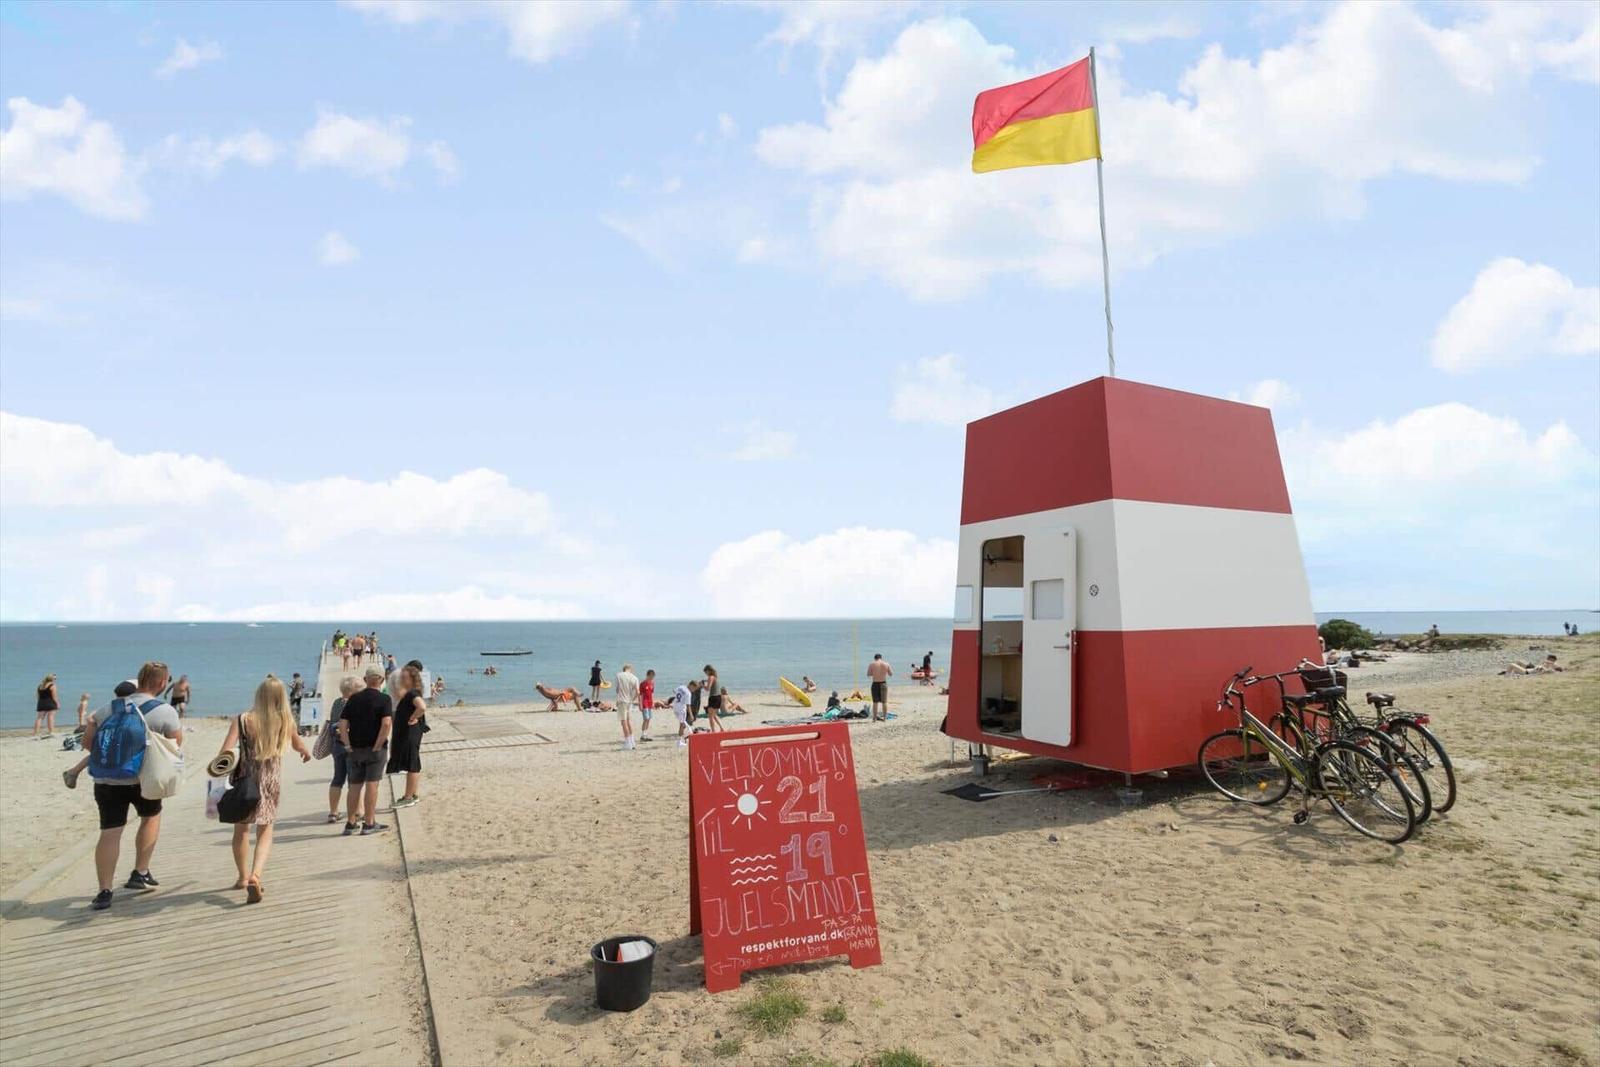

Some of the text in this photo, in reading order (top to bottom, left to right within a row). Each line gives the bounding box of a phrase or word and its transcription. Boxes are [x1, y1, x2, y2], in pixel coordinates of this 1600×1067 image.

[676, 692, 682, 703] 9
[697, 742, 848, 785] VELKOMMEN
[703, 872, 872, 937] JUELSMINDE
[821, 916, 849, 930] PAS
[741, 928, 844, 954] respektforvand.dk
